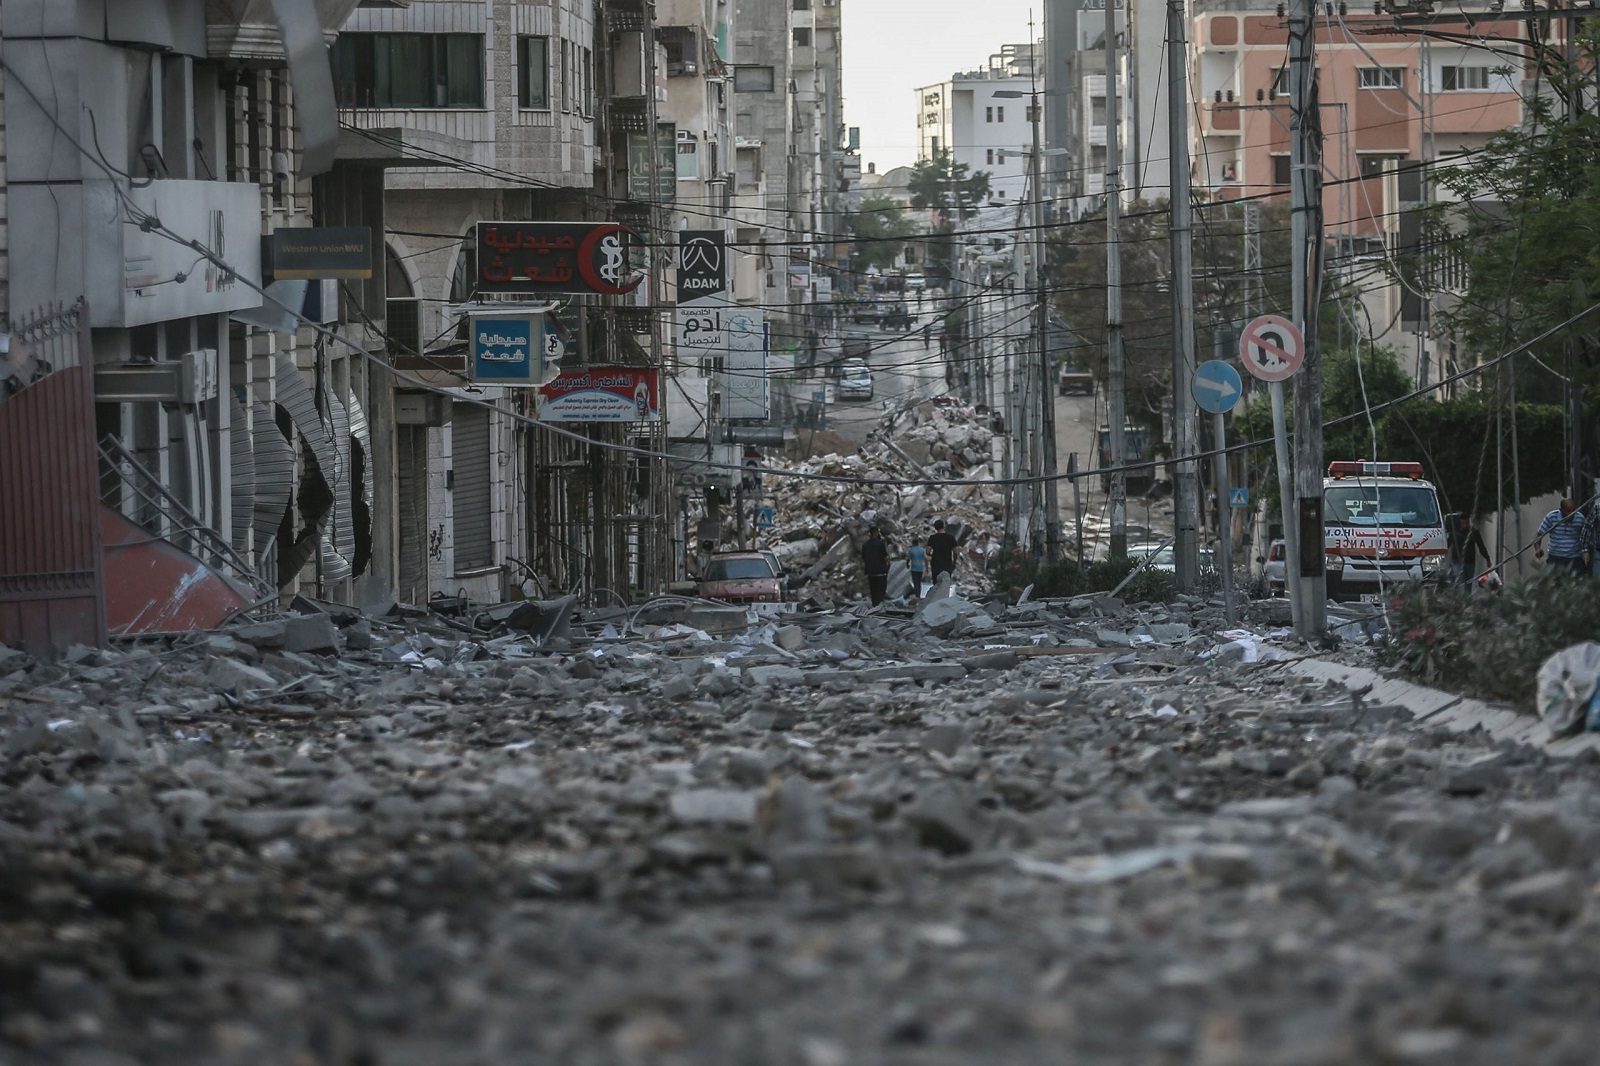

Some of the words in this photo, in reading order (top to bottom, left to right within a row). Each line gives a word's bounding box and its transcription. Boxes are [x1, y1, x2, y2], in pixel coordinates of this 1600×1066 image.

[483, 227, 576, 256] صيدلية
[281, 244, 318, 254] Western
[319, 244, 344, 254] Union
[683, 277, 720, 289] ADAM
[479, 332, 527, 347] صيدلية
[480, 349, 525, 363] شعث
